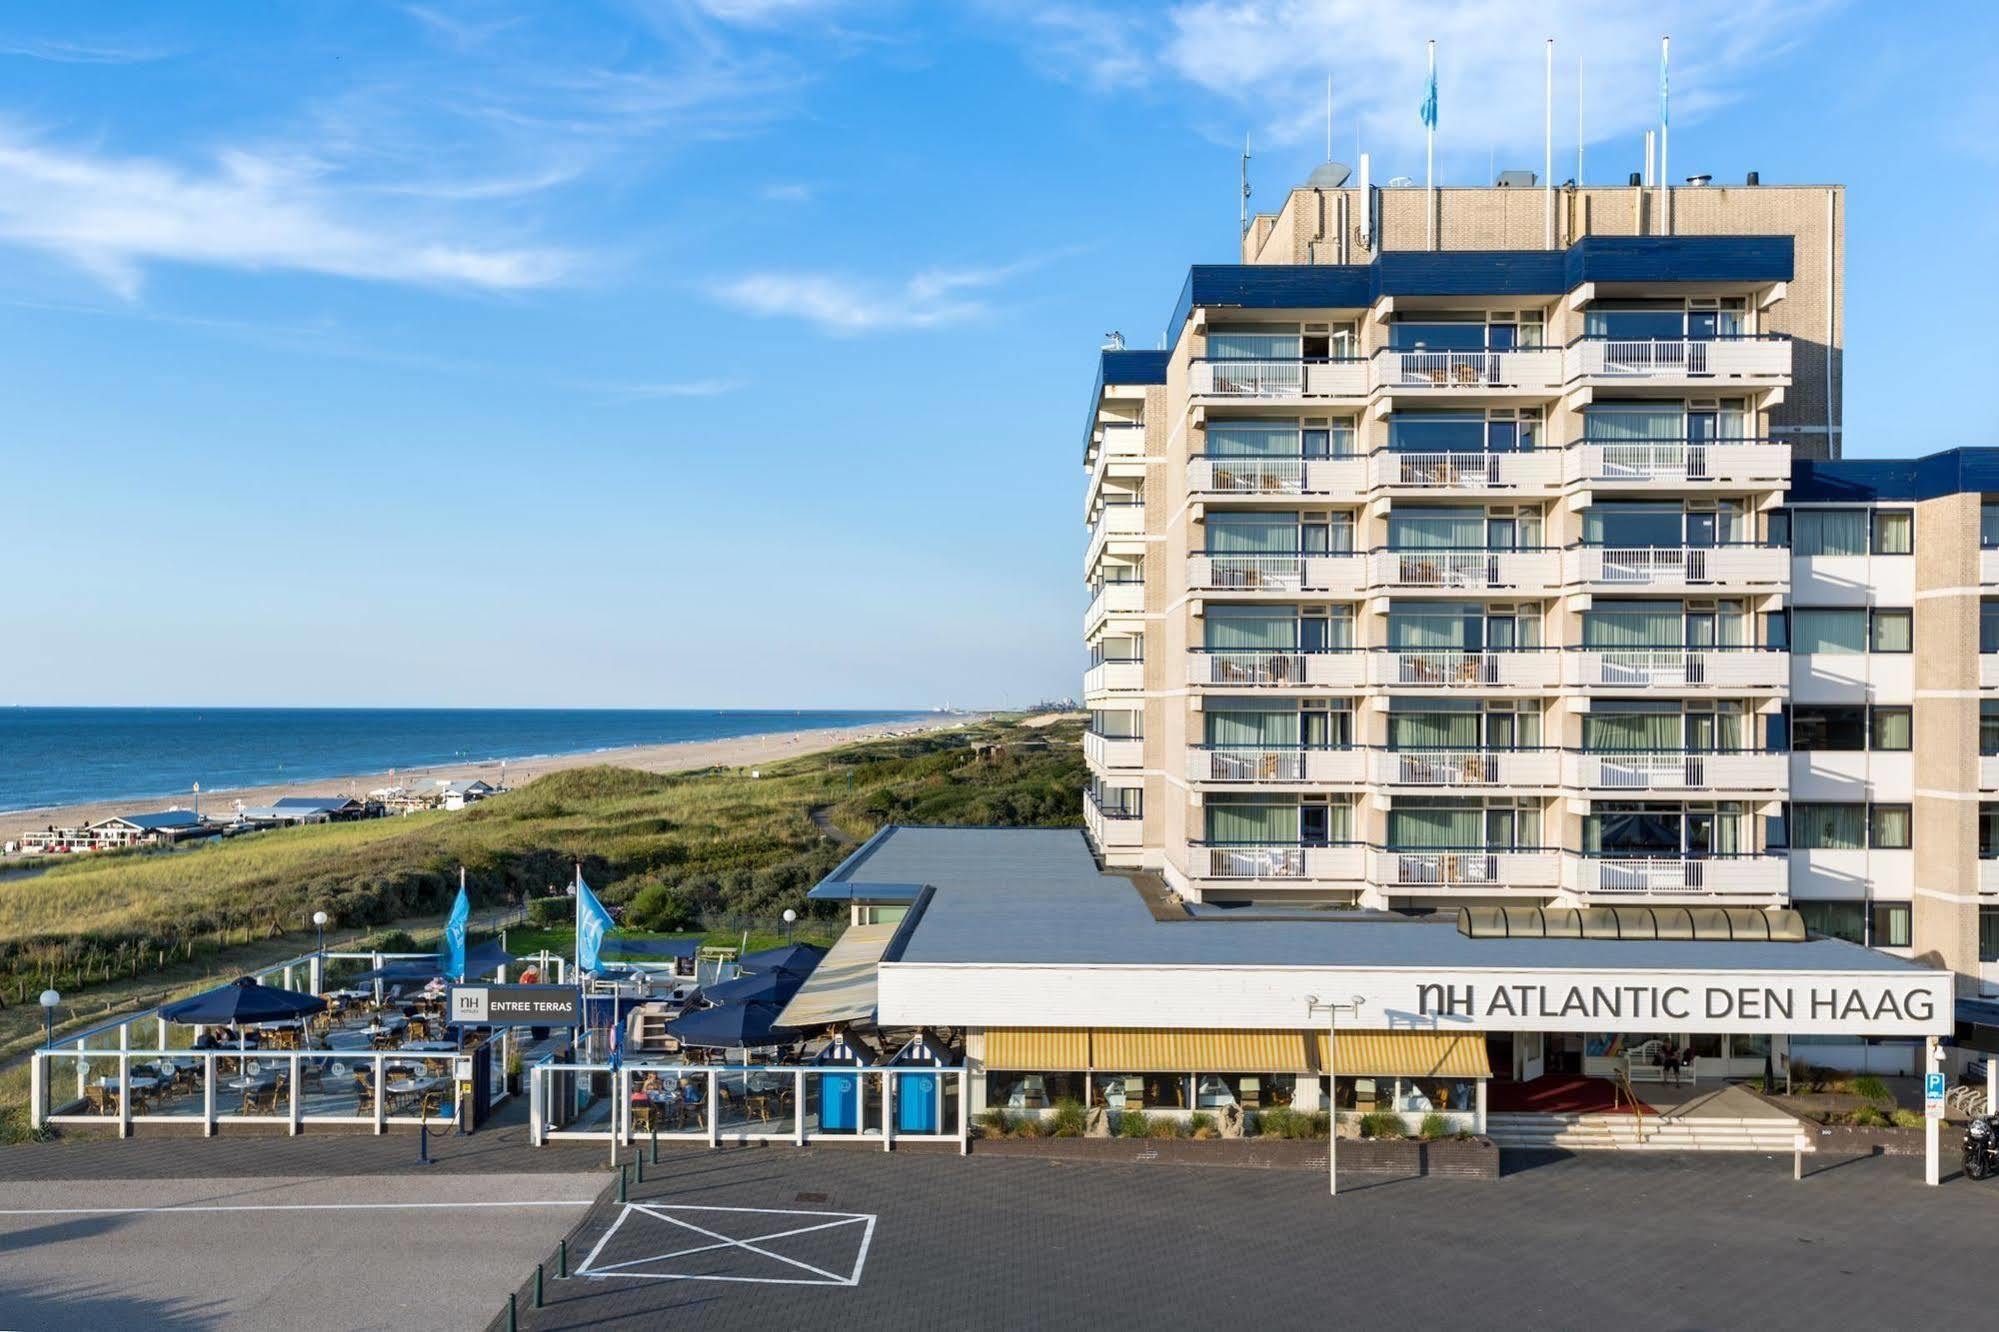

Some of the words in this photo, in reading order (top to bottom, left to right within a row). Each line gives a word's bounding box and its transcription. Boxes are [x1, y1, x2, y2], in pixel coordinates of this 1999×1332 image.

[490, 1001, 530, 1011] ENTREE
[533, 1002, 572, 1011] TERRAS
[1486, 985, 1690, 1018] ATLANTIC
[1705, 987, 1793, 1019] DEN
[1811, 989, 1934, 1021] HAAG
[1930, 1075, 1940, 1090] P
